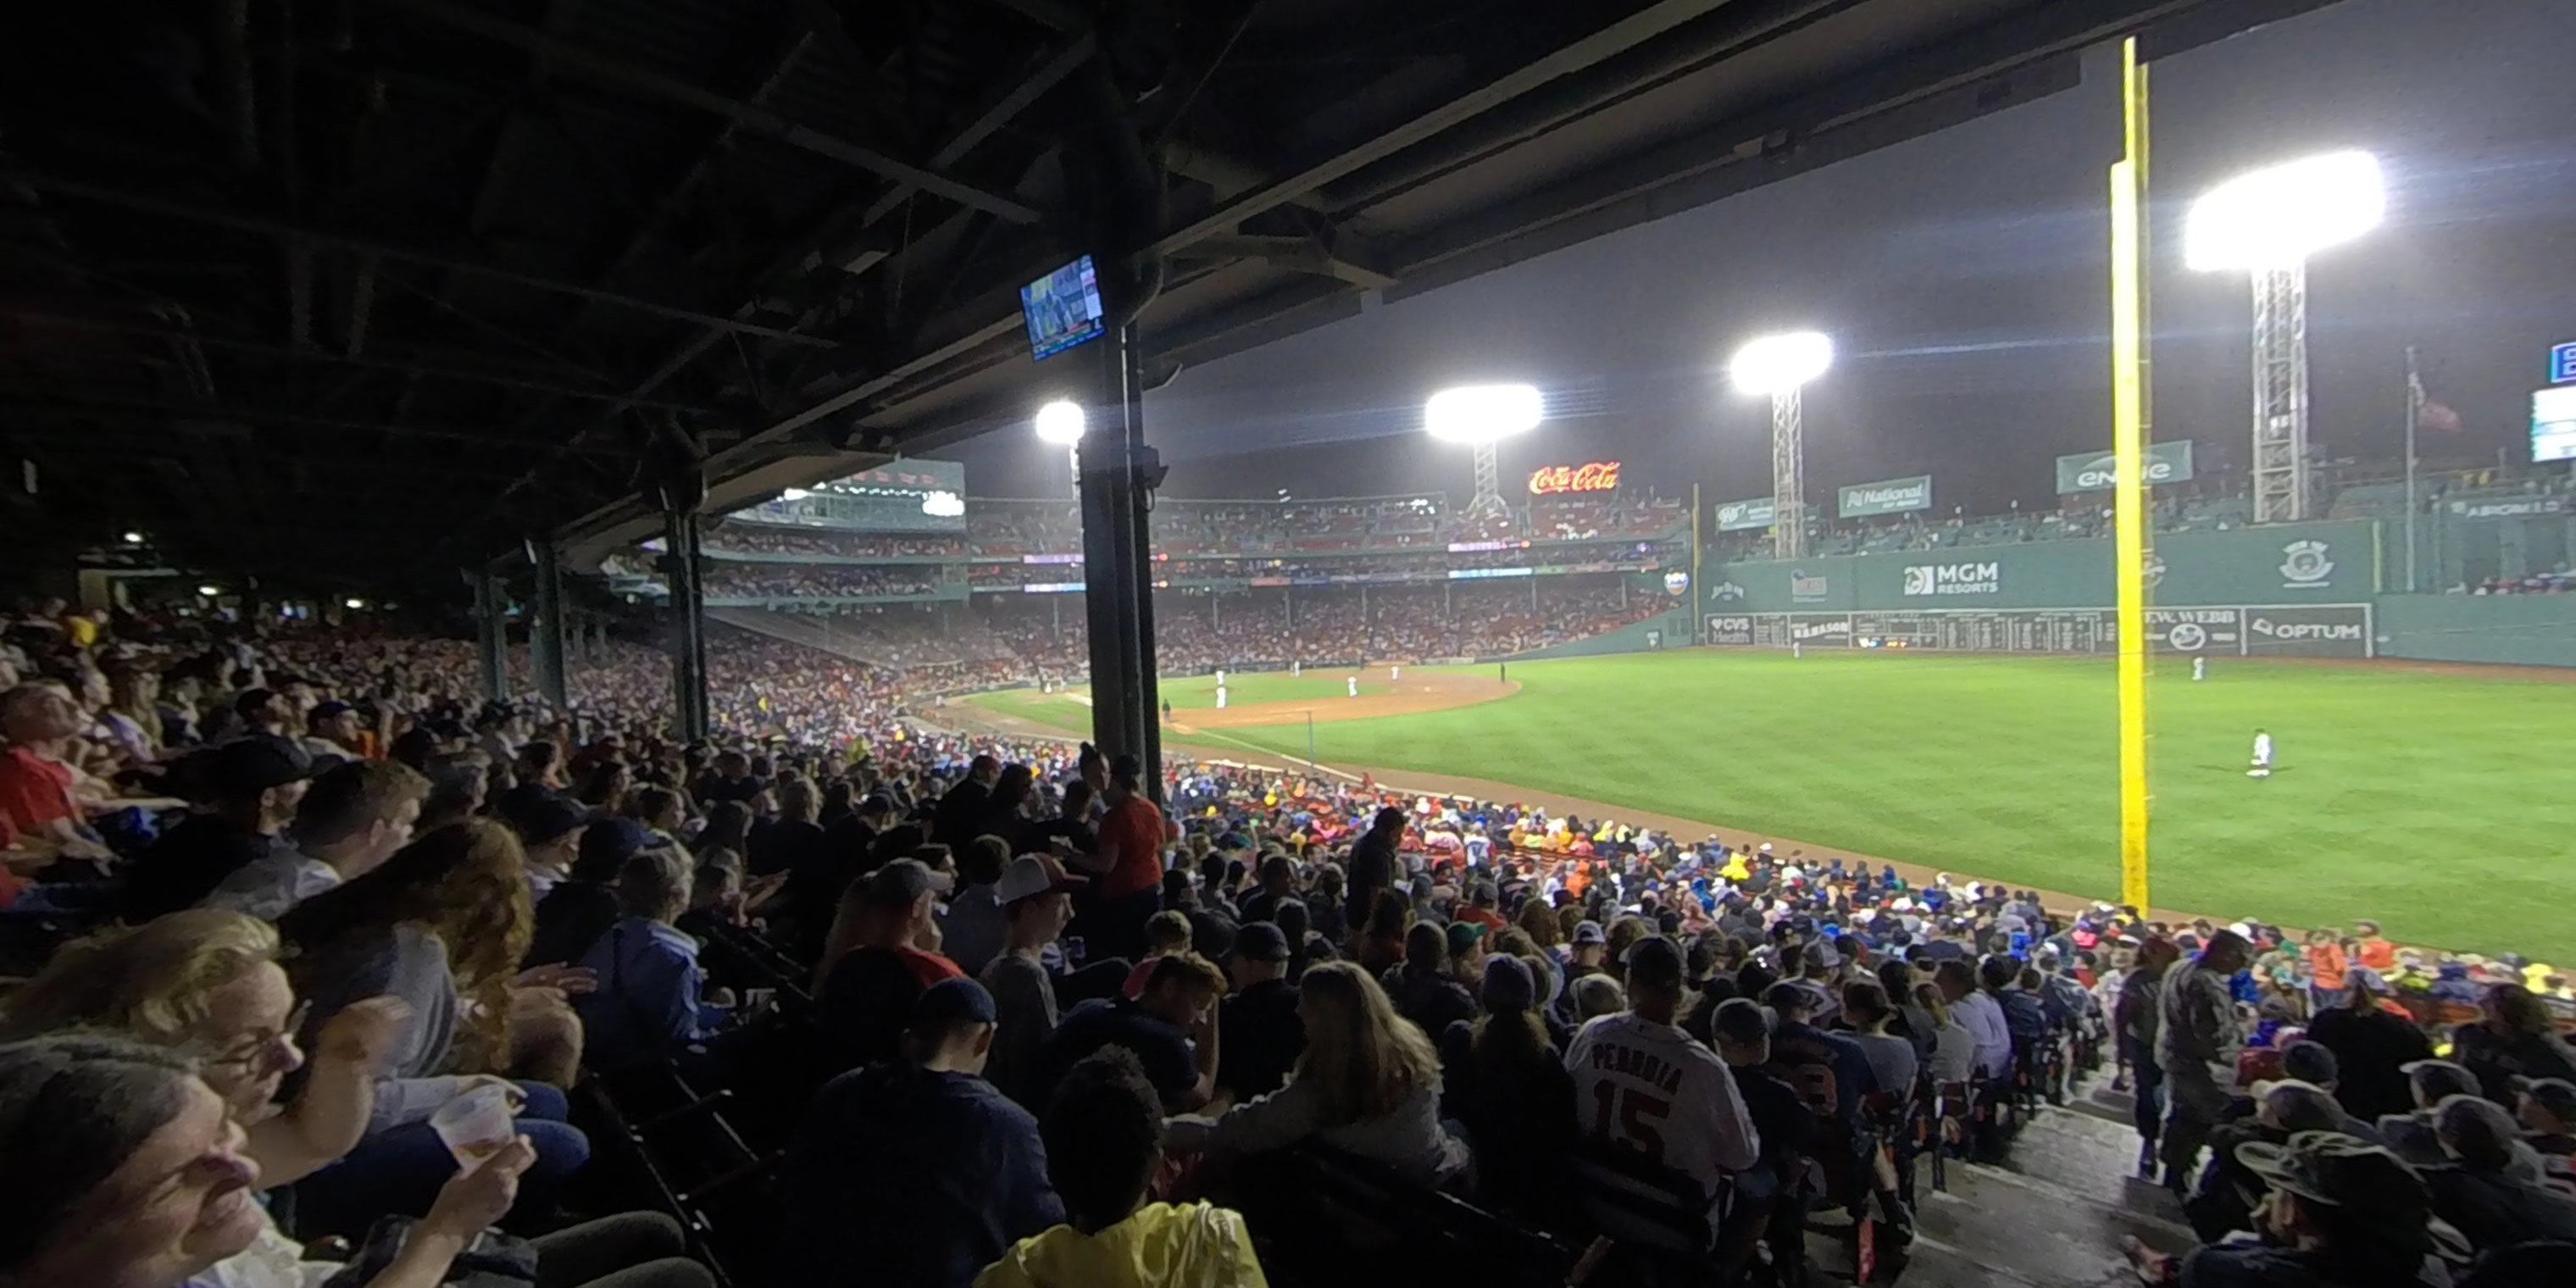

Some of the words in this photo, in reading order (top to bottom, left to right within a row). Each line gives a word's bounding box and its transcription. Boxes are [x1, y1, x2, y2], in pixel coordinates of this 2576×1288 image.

[1863, 483, 1924, 504] National
[1937, 563, 1999, 582] MGM
[1937, 582, 1999, 594] RESORTS
[2178, 610, 2235, 624] WEBB
[1723, 618, 1750, 631] CVS
[1713, 630, 1751, 644] Health
[2276, 625, 2362, 639] OPTUM
[1593, 1079, 1671, 1166] 15
